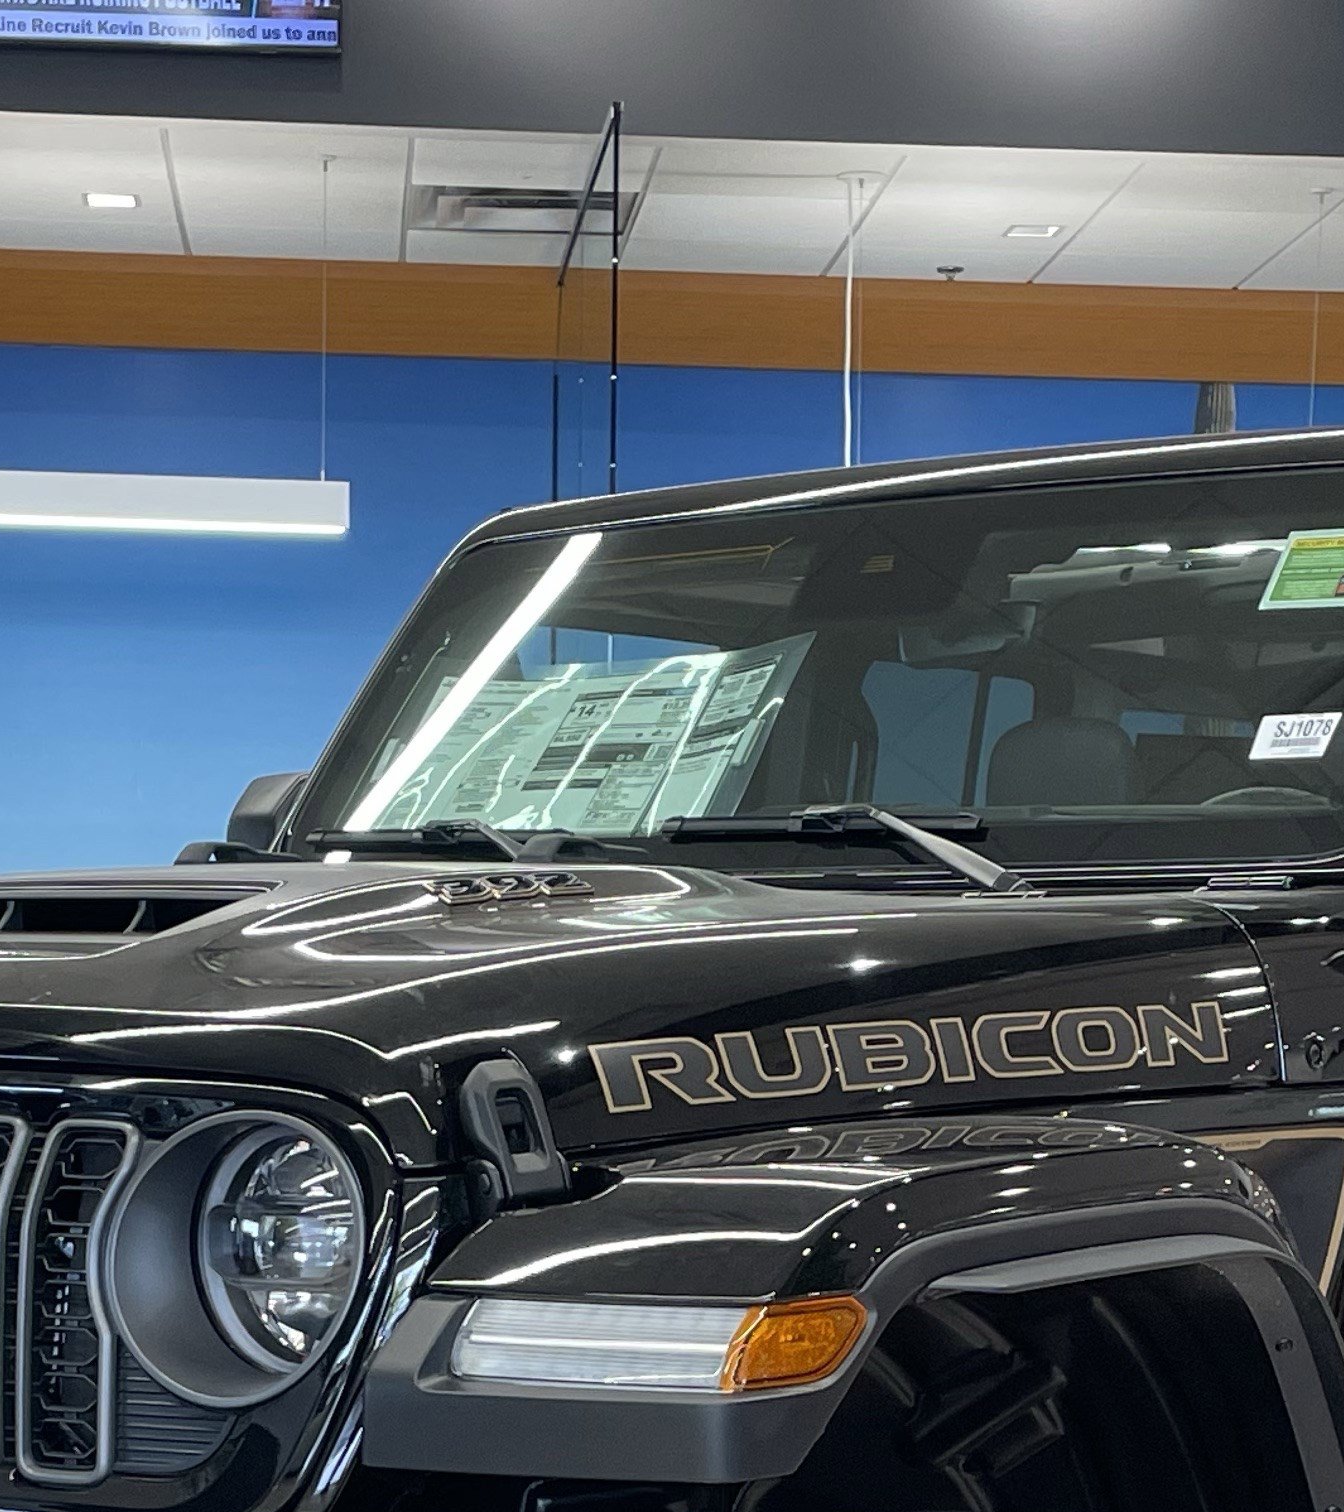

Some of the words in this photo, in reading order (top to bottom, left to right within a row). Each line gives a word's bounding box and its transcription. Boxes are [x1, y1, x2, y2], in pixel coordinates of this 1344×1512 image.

[31, 17, 93, 34] Recruit
[97, 20, 143, 36] Kevin
[148, 21, 201, 38] Brown
[206, 24, 257, 40] joined
[262, 27, 281, 40] us
[285, 26, 303, 40] to
[307, 28, 337, 42] ann
[1274, 719, 1334, 738] SJ1078
[588, 1001, 1229, 1114] RUBICON
